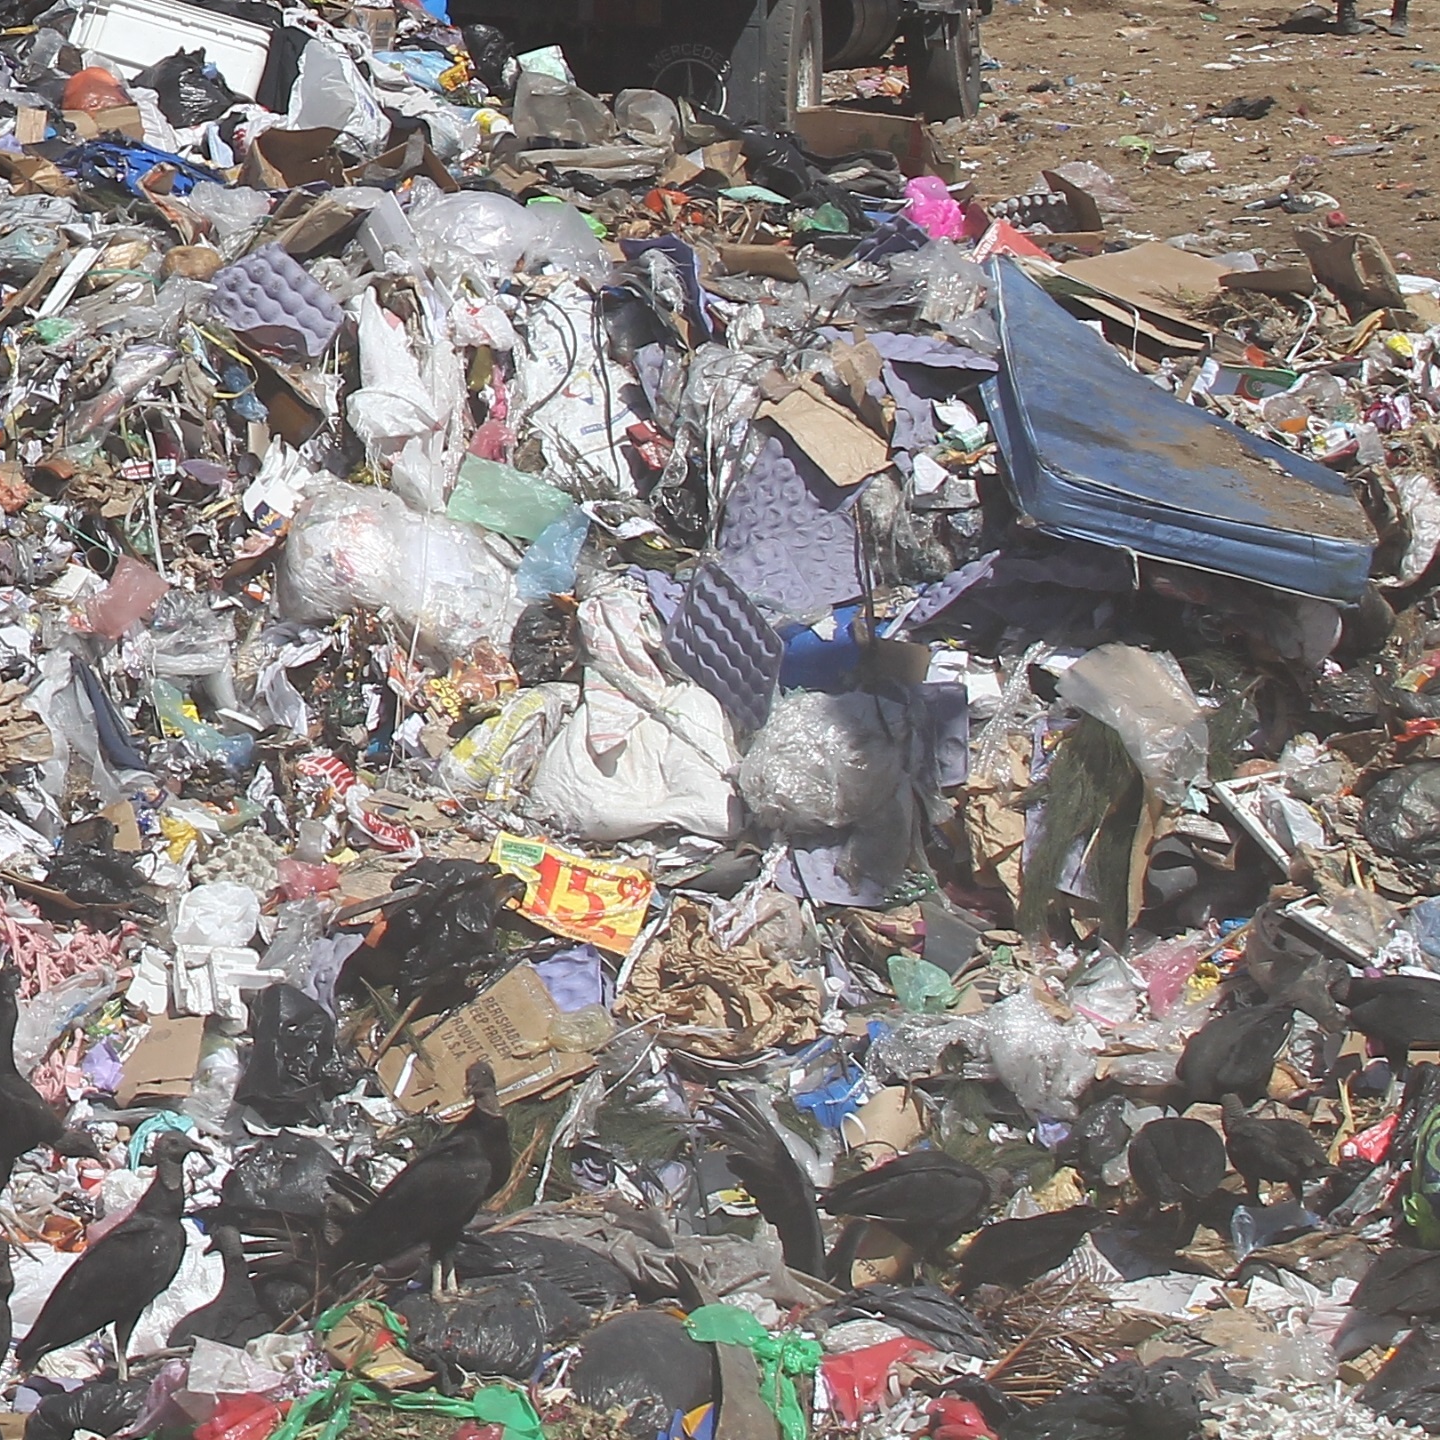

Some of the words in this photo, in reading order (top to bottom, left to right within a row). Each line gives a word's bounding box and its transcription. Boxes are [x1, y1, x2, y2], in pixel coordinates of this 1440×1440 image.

[481, 996, 524, 1051] PERISHABLE
[482, 1024, 514, 1061] FROZEN
[857, 1259, 891, 1284] FRAG
